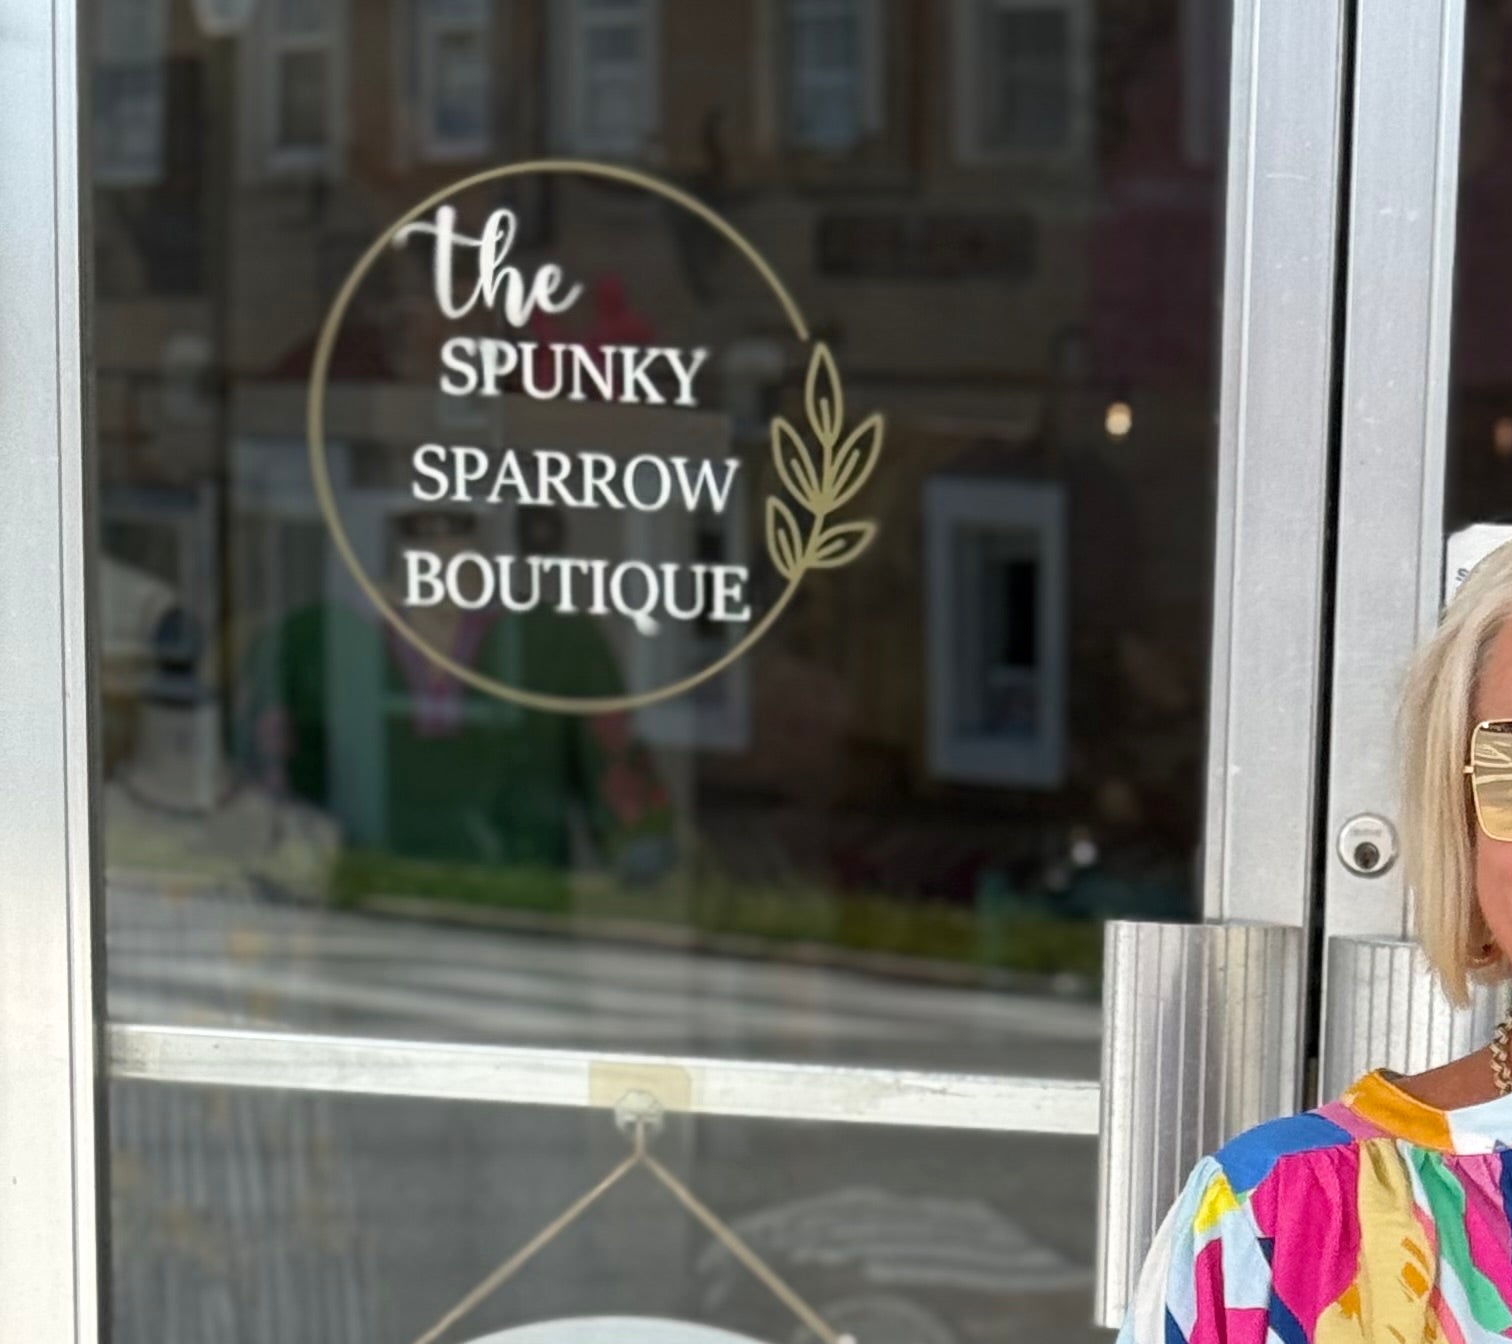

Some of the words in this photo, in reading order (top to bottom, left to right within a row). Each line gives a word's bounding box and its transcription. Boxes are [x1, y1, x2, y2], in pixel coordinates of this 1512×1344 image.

[393, 205, 584, 328] the
[440, 337, 708, 406] SPUNKY
[411, 443, 741, 513] SPARROW
[403, 549, 752, 637] BOUTIQUE
